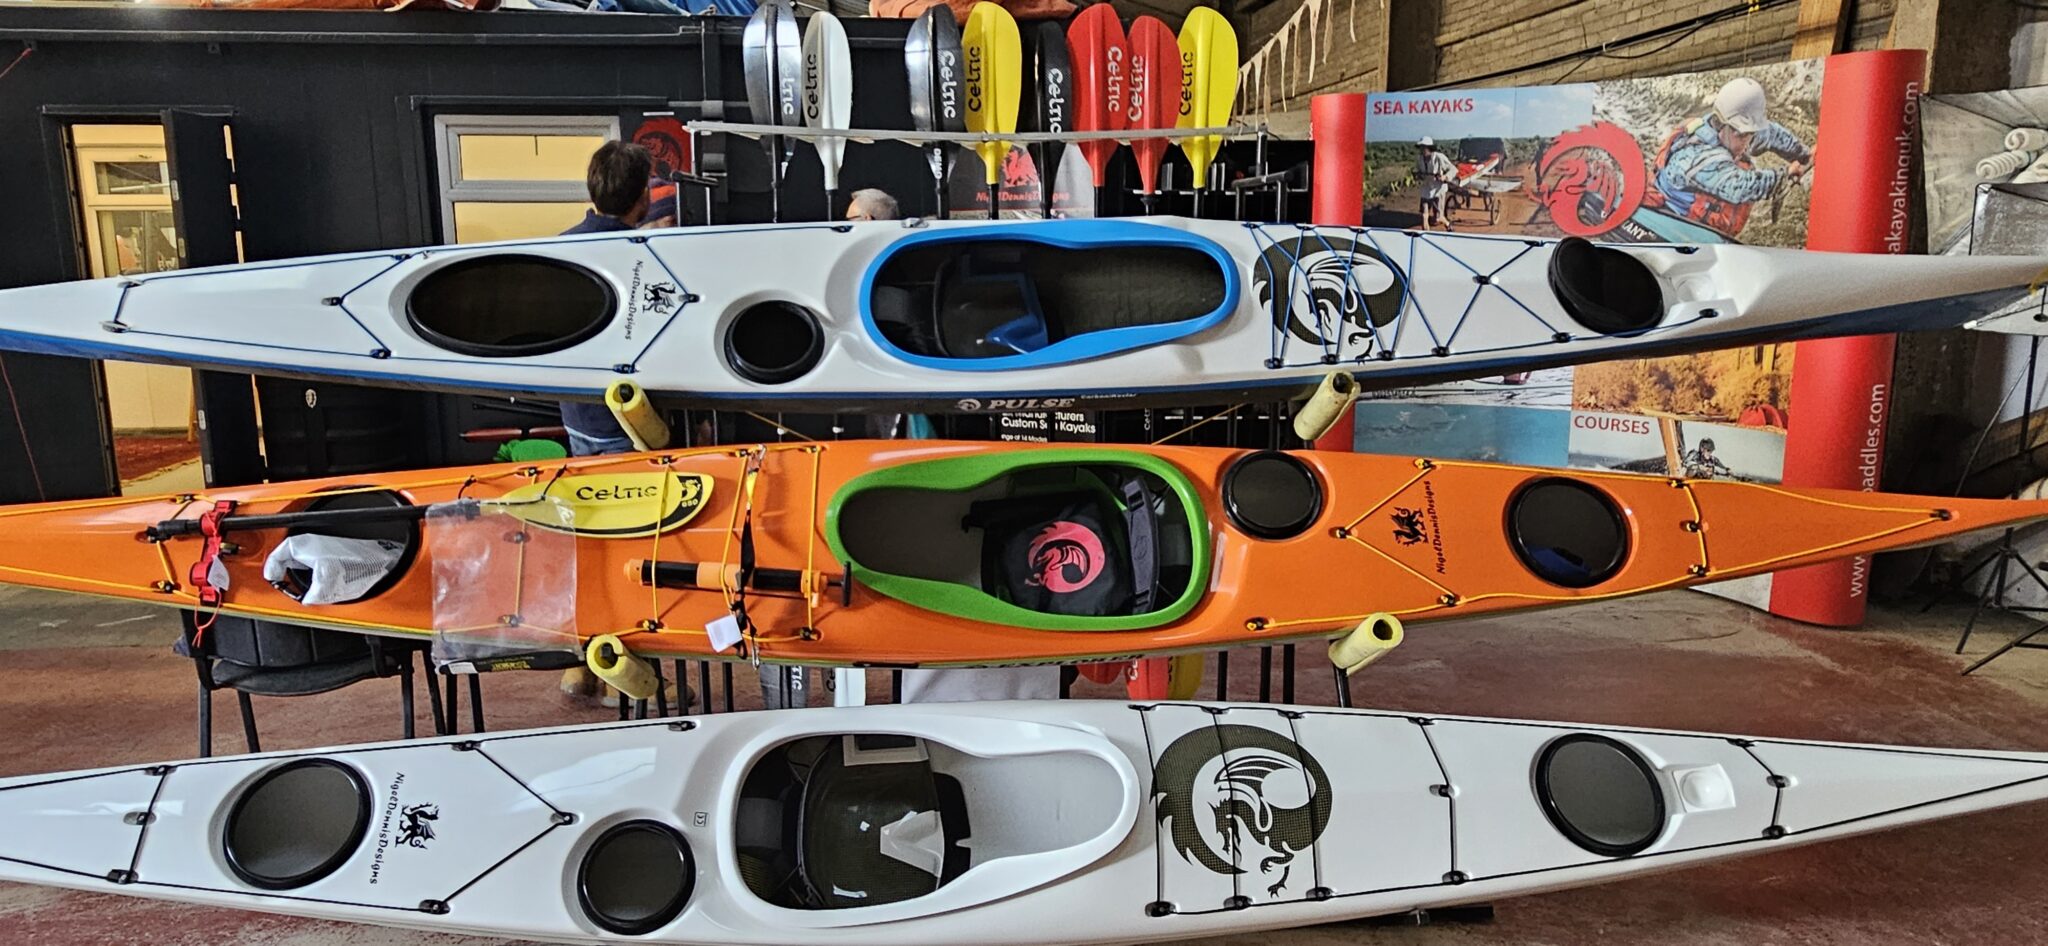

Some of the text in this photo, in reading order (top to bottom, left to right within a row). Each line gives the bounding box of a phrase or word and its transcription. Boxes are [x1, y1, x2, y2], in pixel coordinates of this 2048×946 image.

[1108, 46, 1123, 112] Celtic
[1373, 98, 1474, 115] SEA KAYAKS
[934, 147, 943, 180] DEMO
[987, 398, 1076, 409] PULSE
[1001, 417, 1038, 429] Custom
[1060, 420, 1096, 434] Kayaks
[1574, 415, 1650, 435] COURSES
[1859, 383, 1885, 493] addles.com
[369, 772, 406, 884] NigelDennisDesigns
